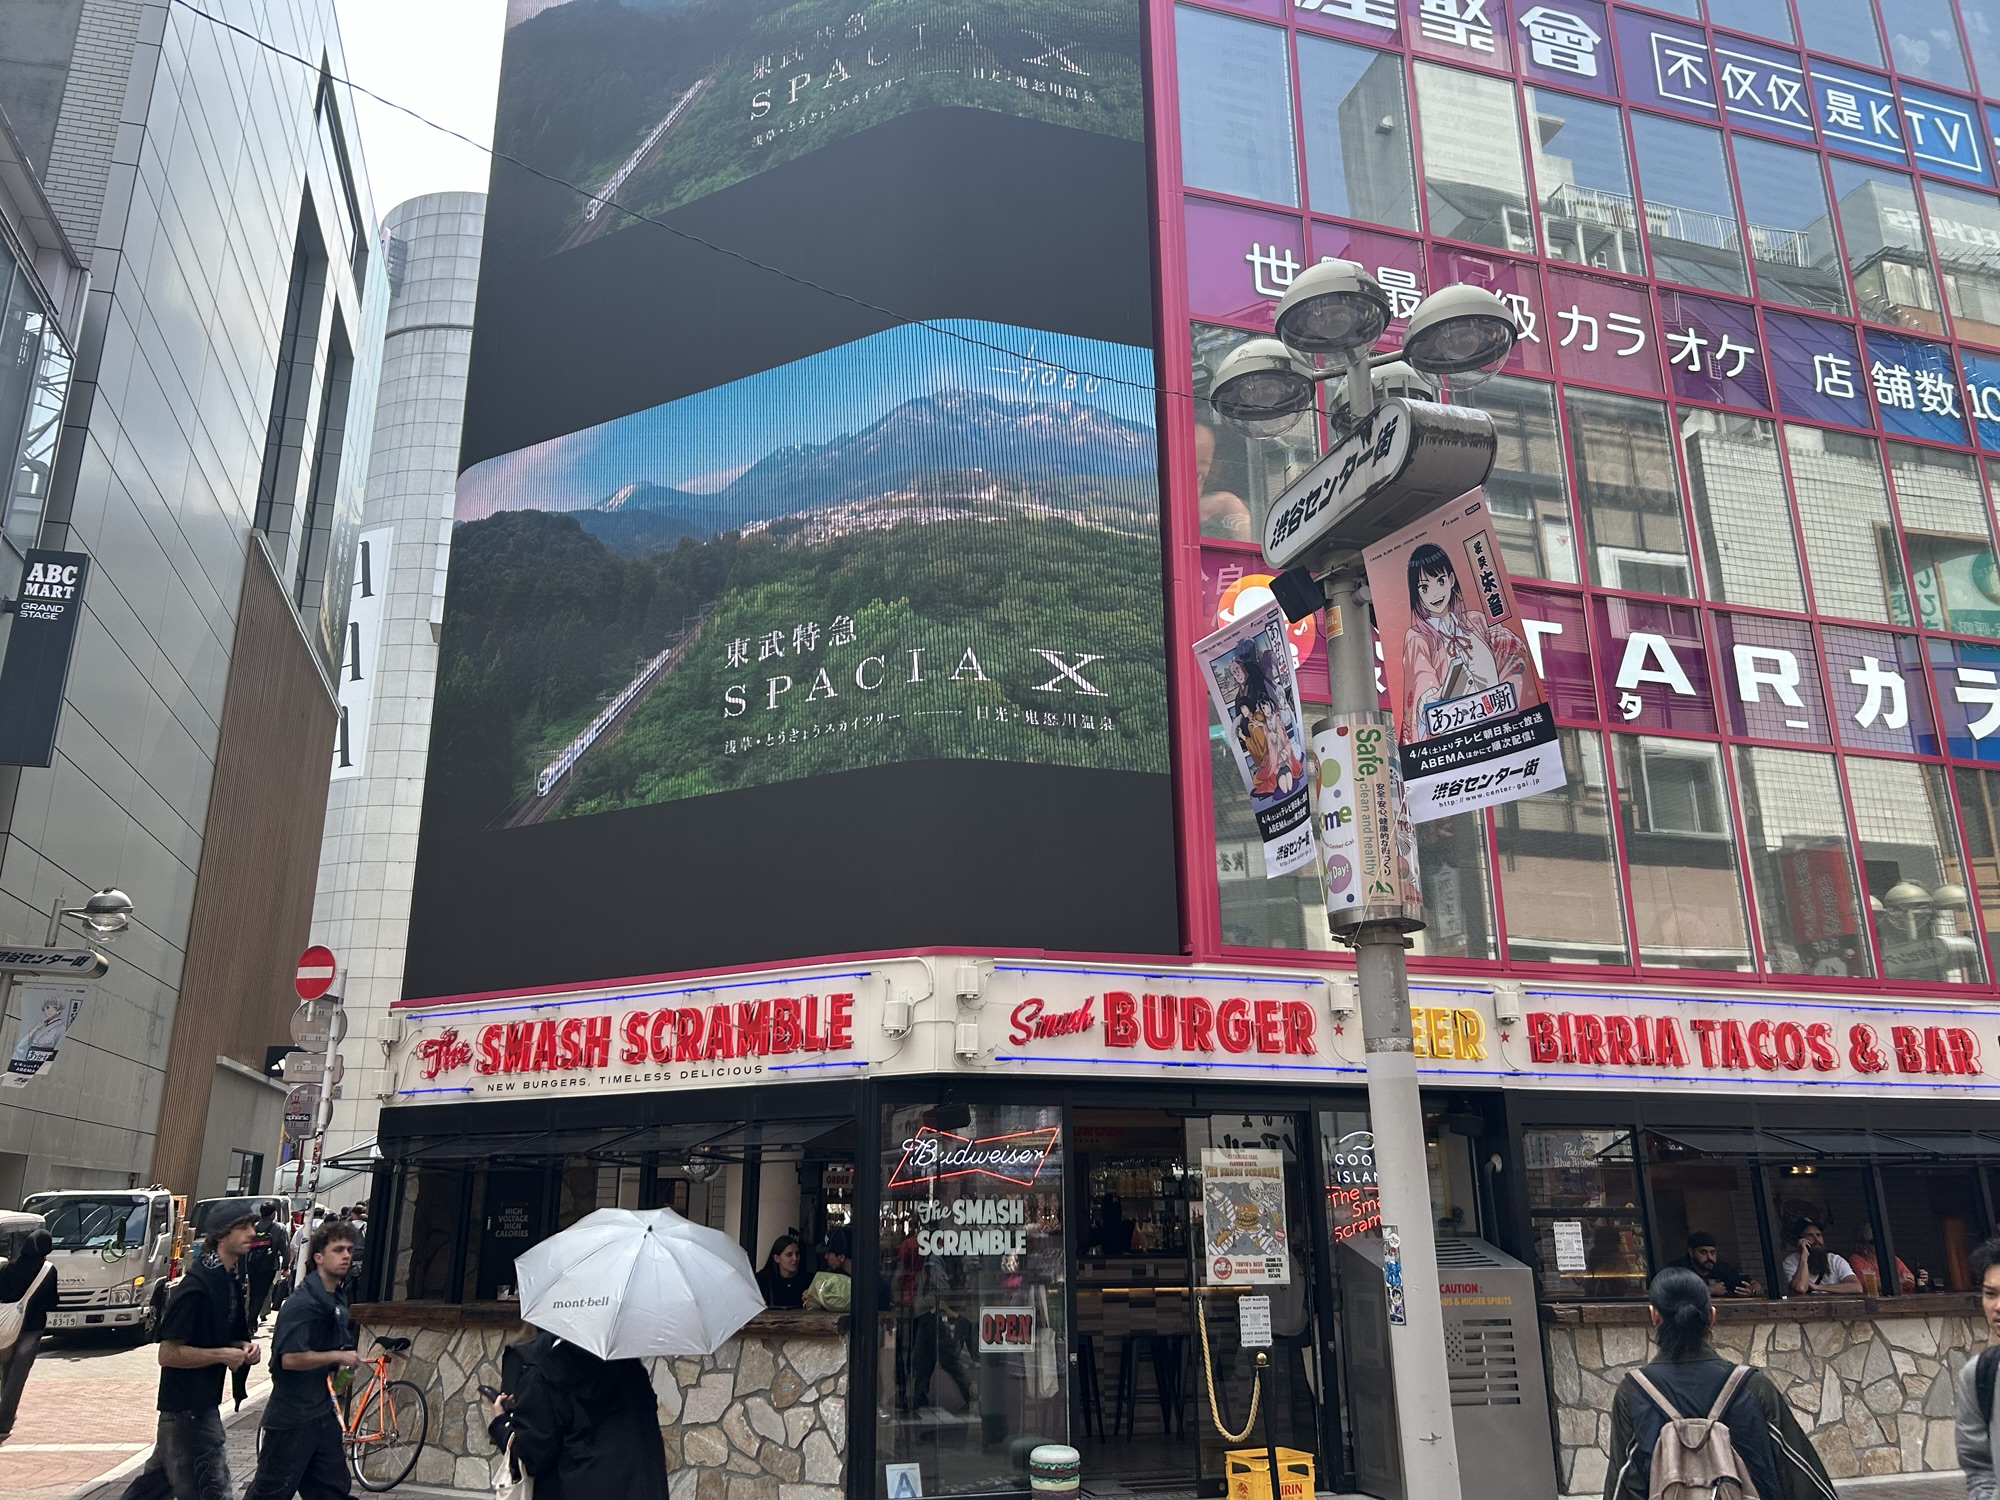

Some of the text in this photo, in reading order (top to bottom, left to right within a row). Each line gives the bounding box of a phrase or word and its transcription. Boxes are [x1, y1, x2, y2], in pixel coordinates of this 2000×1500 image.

[1665, 48, 1959, 152] 不仅仅是KTV
[1270, 415, 1398, 550] 渋谷センター街
[27, 562, 78, 585] ABC
[24, 582, 75, 599] MART
[20, 611, 59, 620] STAGE
[21, 602, 64, 613] GRAND
[725, 615, 857, 669] 東武特急
[724, 647, 1109, 718] SPACIA X
[1432, 758, 1540, 801] 渋谷センター街
[1354, 728, 1384, 877] Safe, clean and healthy
[416, 993, 854, 1080] The SMASH SCRAMBLE
[1008, 990, 1984, 1075] Smash BURGER EER BIRRIA TACOS & BAR
[487, 1064, 763, 1093] NEW BURGERS, TIMELESS DELICIOUS
[902, 1139, 1045, 1166] Budweiser
[1335, 1153, 1372, 1166] GOO
[1205, 1166, 1218, 1178] THE
[1337, 1170, 1379, 1183] ISLAN
[917, 1199, 1024, 1225] The SMASH
[495, 1230, 529, 1238] CALORIES
[1334, 1214, 1382, 1242] Scram
[917, 1229, 1027, 1256] SCRAMBLE
[1440, 1283, 1478, 1293] CAUTION
[1461, 1297, 1486, 1305] HIGHER
[1487, 1296, 1512, 1305] SPIRITS
[981, 1313, 1033, 1345] OPEN
[894, 1472, 918, 1500] A
[1281, 1483, 1303, 1496] IRIN
